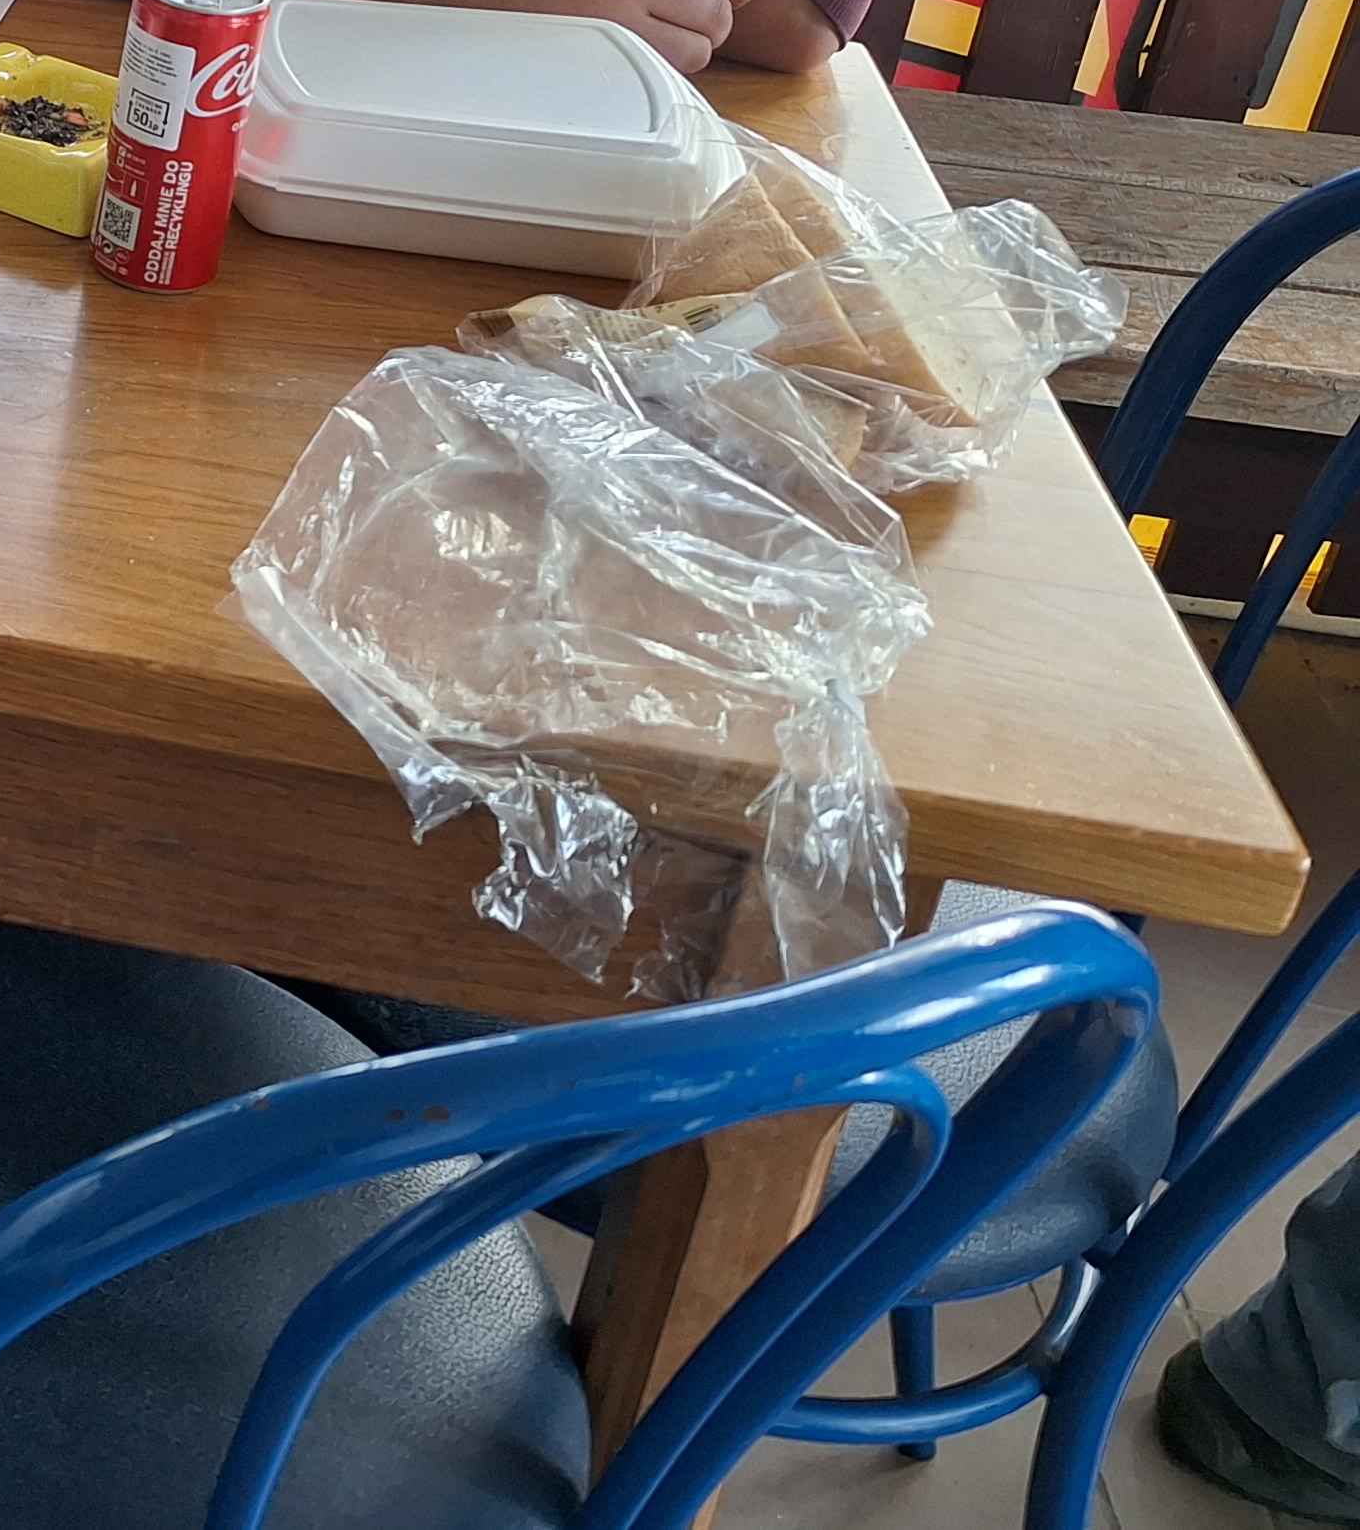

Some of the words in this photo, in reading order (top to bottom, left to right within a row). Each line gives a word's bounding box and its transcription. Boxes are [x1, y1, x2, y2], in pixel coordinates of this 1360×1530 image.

[162, 159, 180, 184] DO
[155, 185, 175, 229] MNIE
[164, 161, 194, 250] RECYKLINGU
[143, 230, 166, 283] ODDAJ
